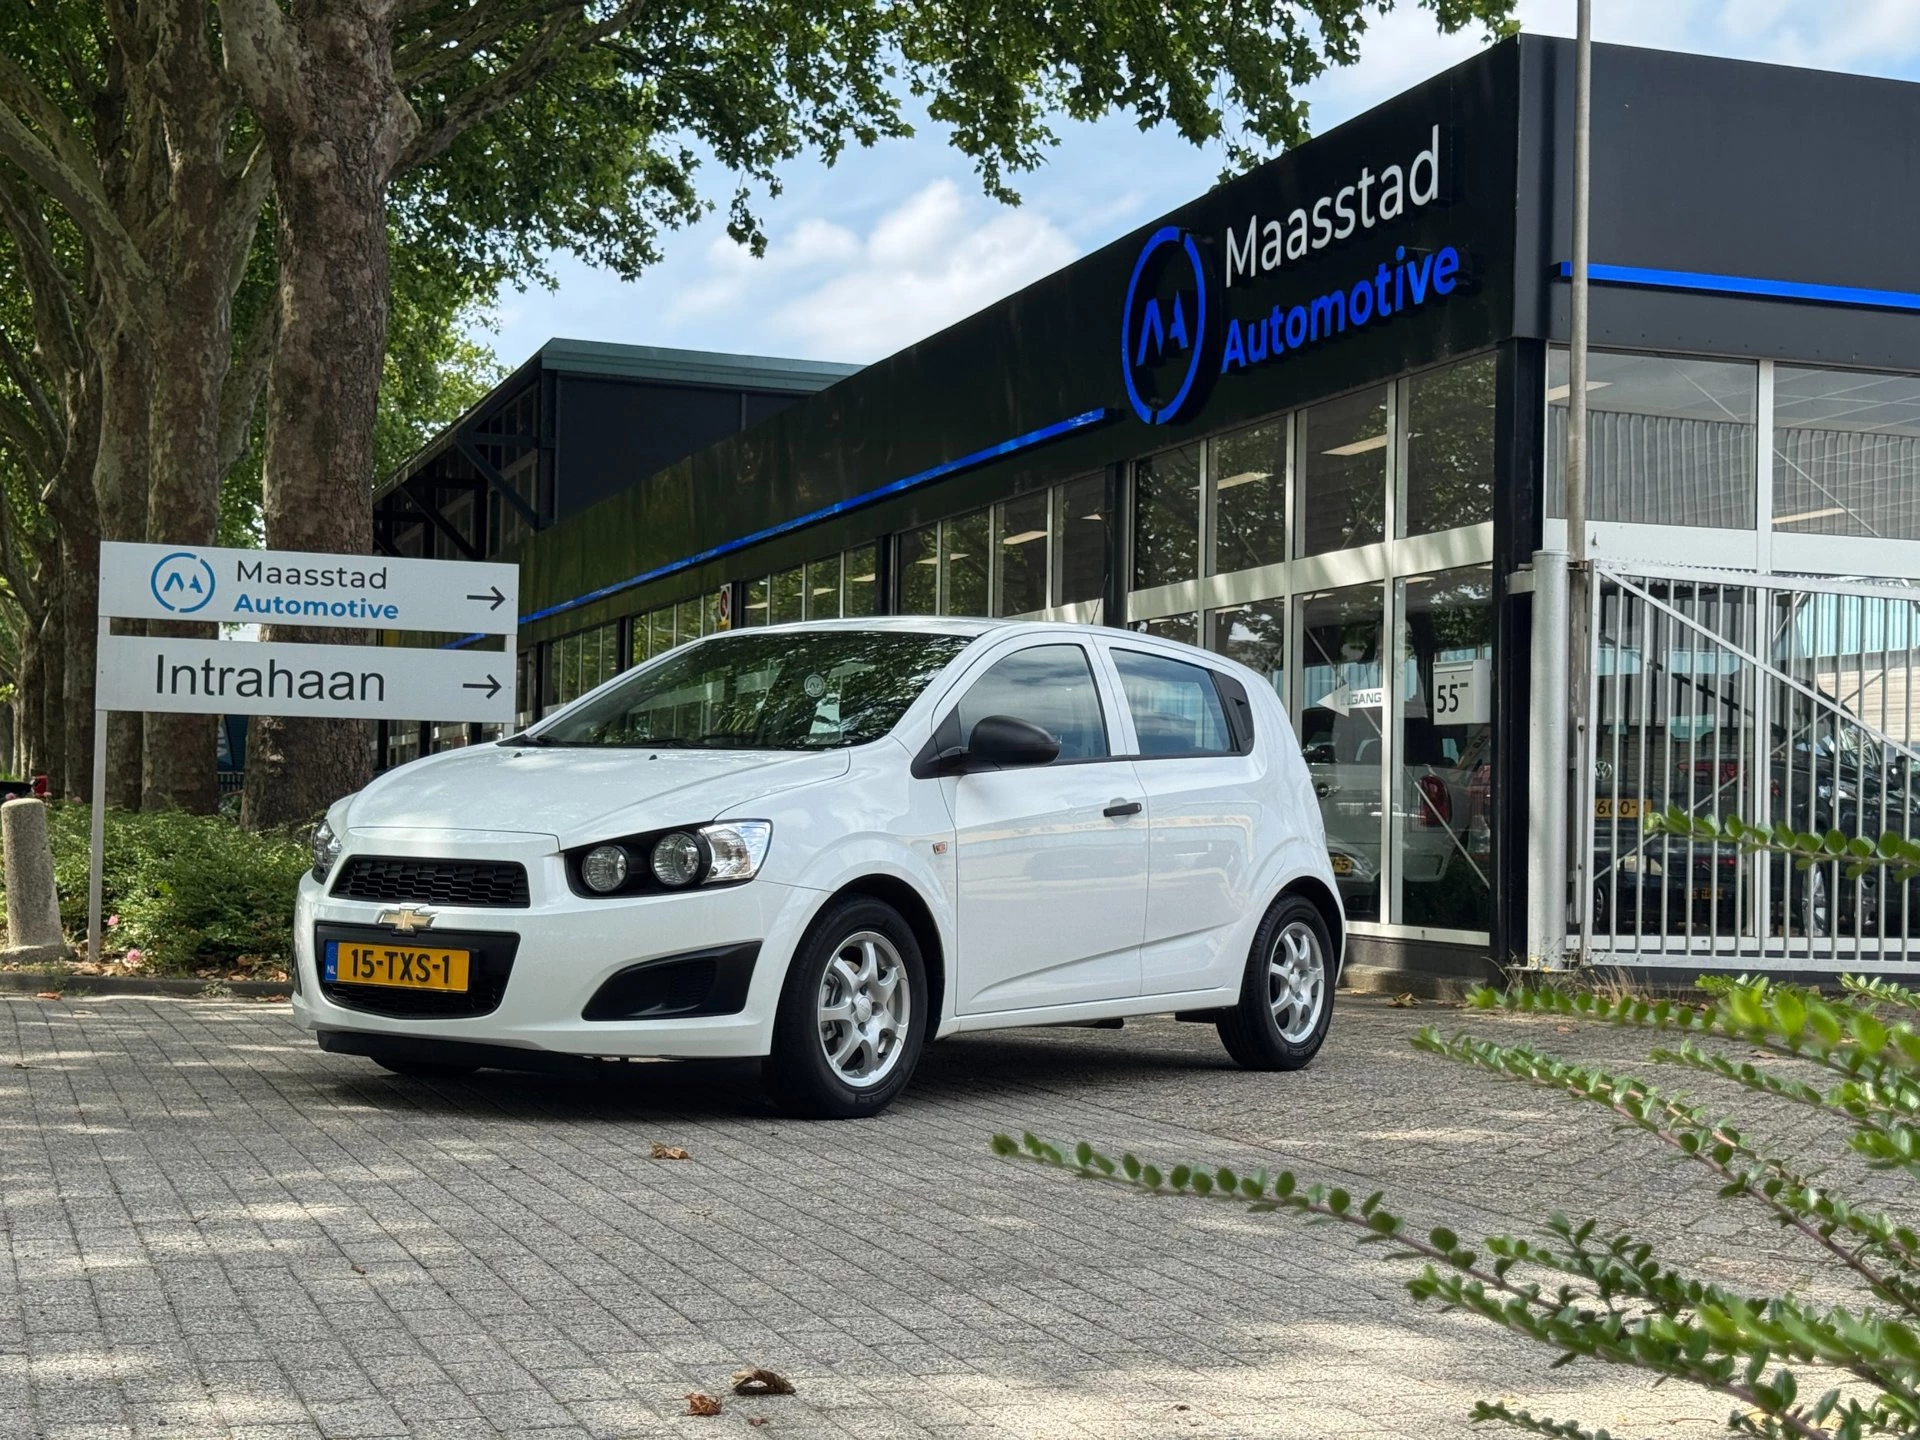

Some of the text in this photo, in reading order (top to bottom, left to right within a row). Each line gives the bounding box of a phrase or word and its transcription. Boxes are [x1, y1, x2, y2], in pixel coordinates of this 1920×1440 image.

[1226, 124, 1439, 288] Maasstad
[1221, 246, 1459, 374] Automotive
[237, 560, 387, 590] Maasstad
[233, 593, 399, 620] Automotive
[156, 654, 385, 701] Intrahaan
[326, 948, 450, 984] NL 15-TXS-1
